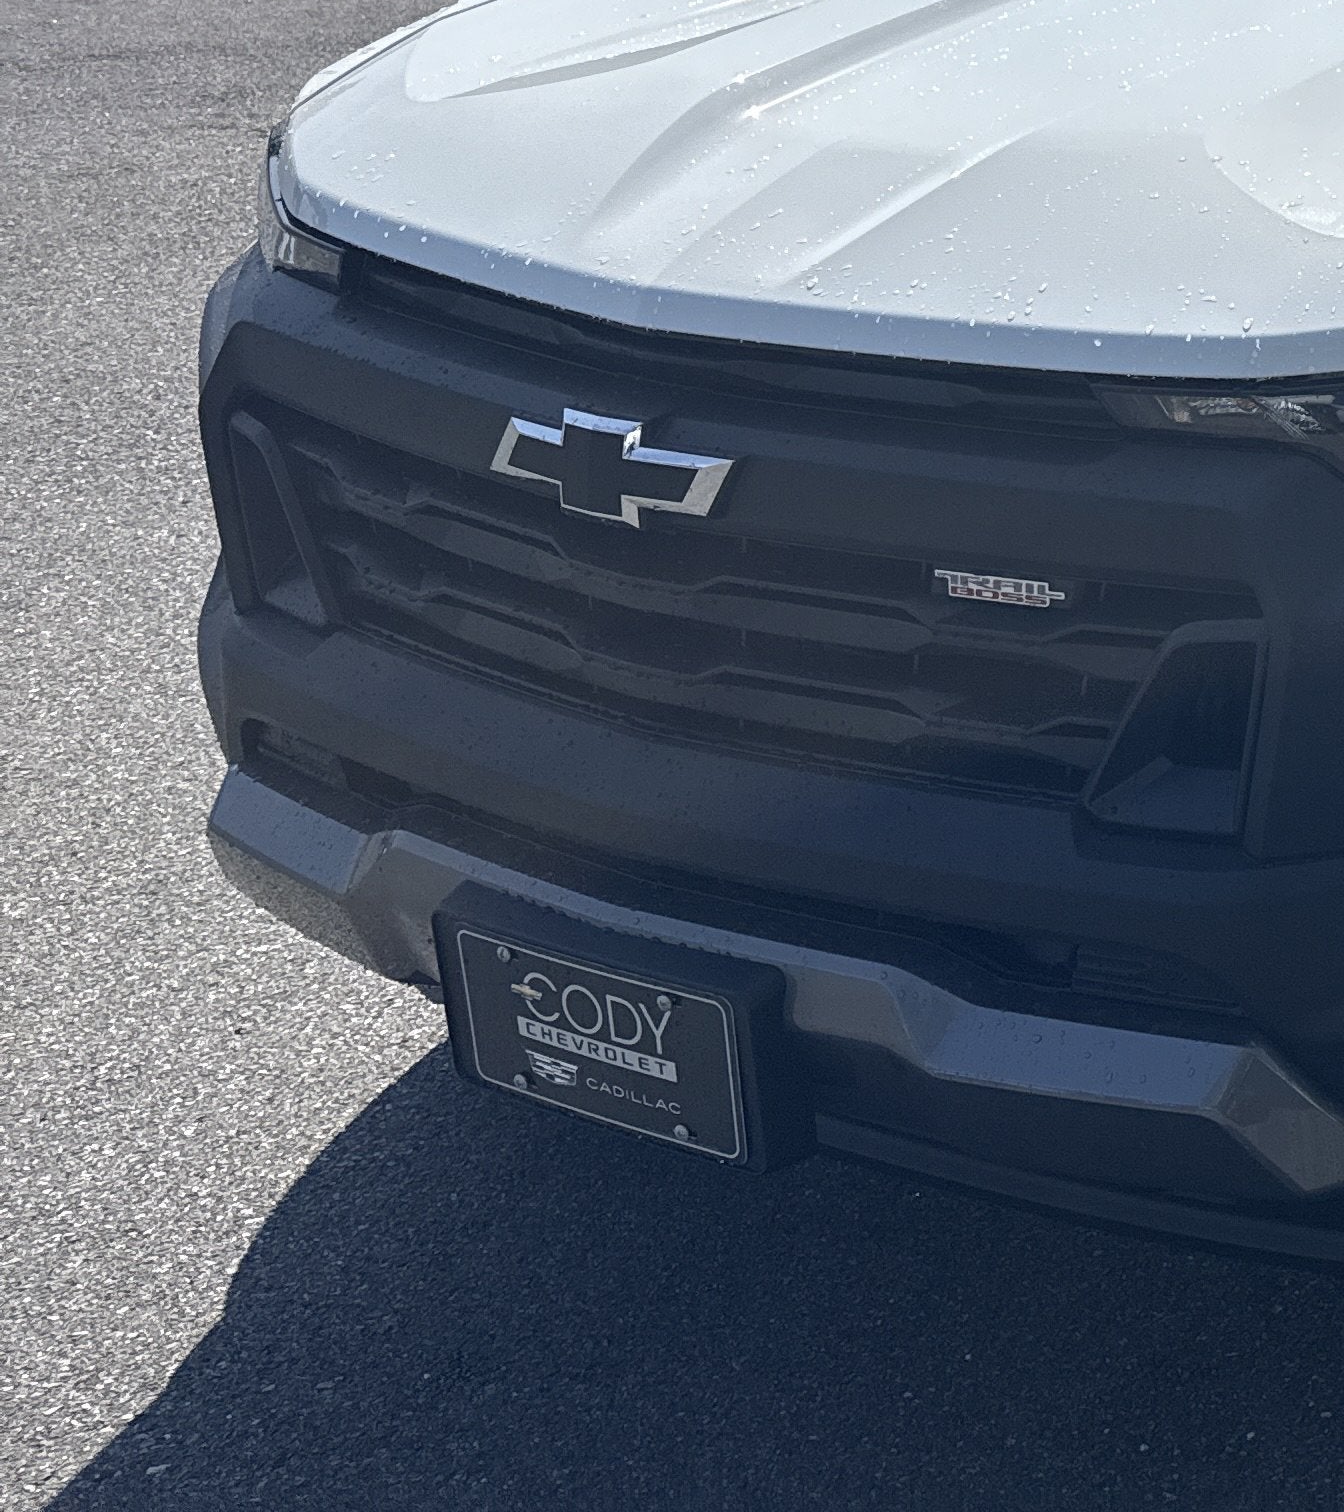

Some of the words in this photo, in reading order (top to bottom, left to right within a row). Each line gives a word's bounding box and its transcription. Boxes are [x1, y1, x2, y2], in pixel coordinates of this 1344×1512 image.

[935, 569, 1065, 600] TRAIL
[949, 585, 1050, 607] BOSS
[521, 972, 671, 1055] CODY
[522, 1020, 670, 1078] CHEVROLET
[585, 1077, 682, 1116] CADILLAC
